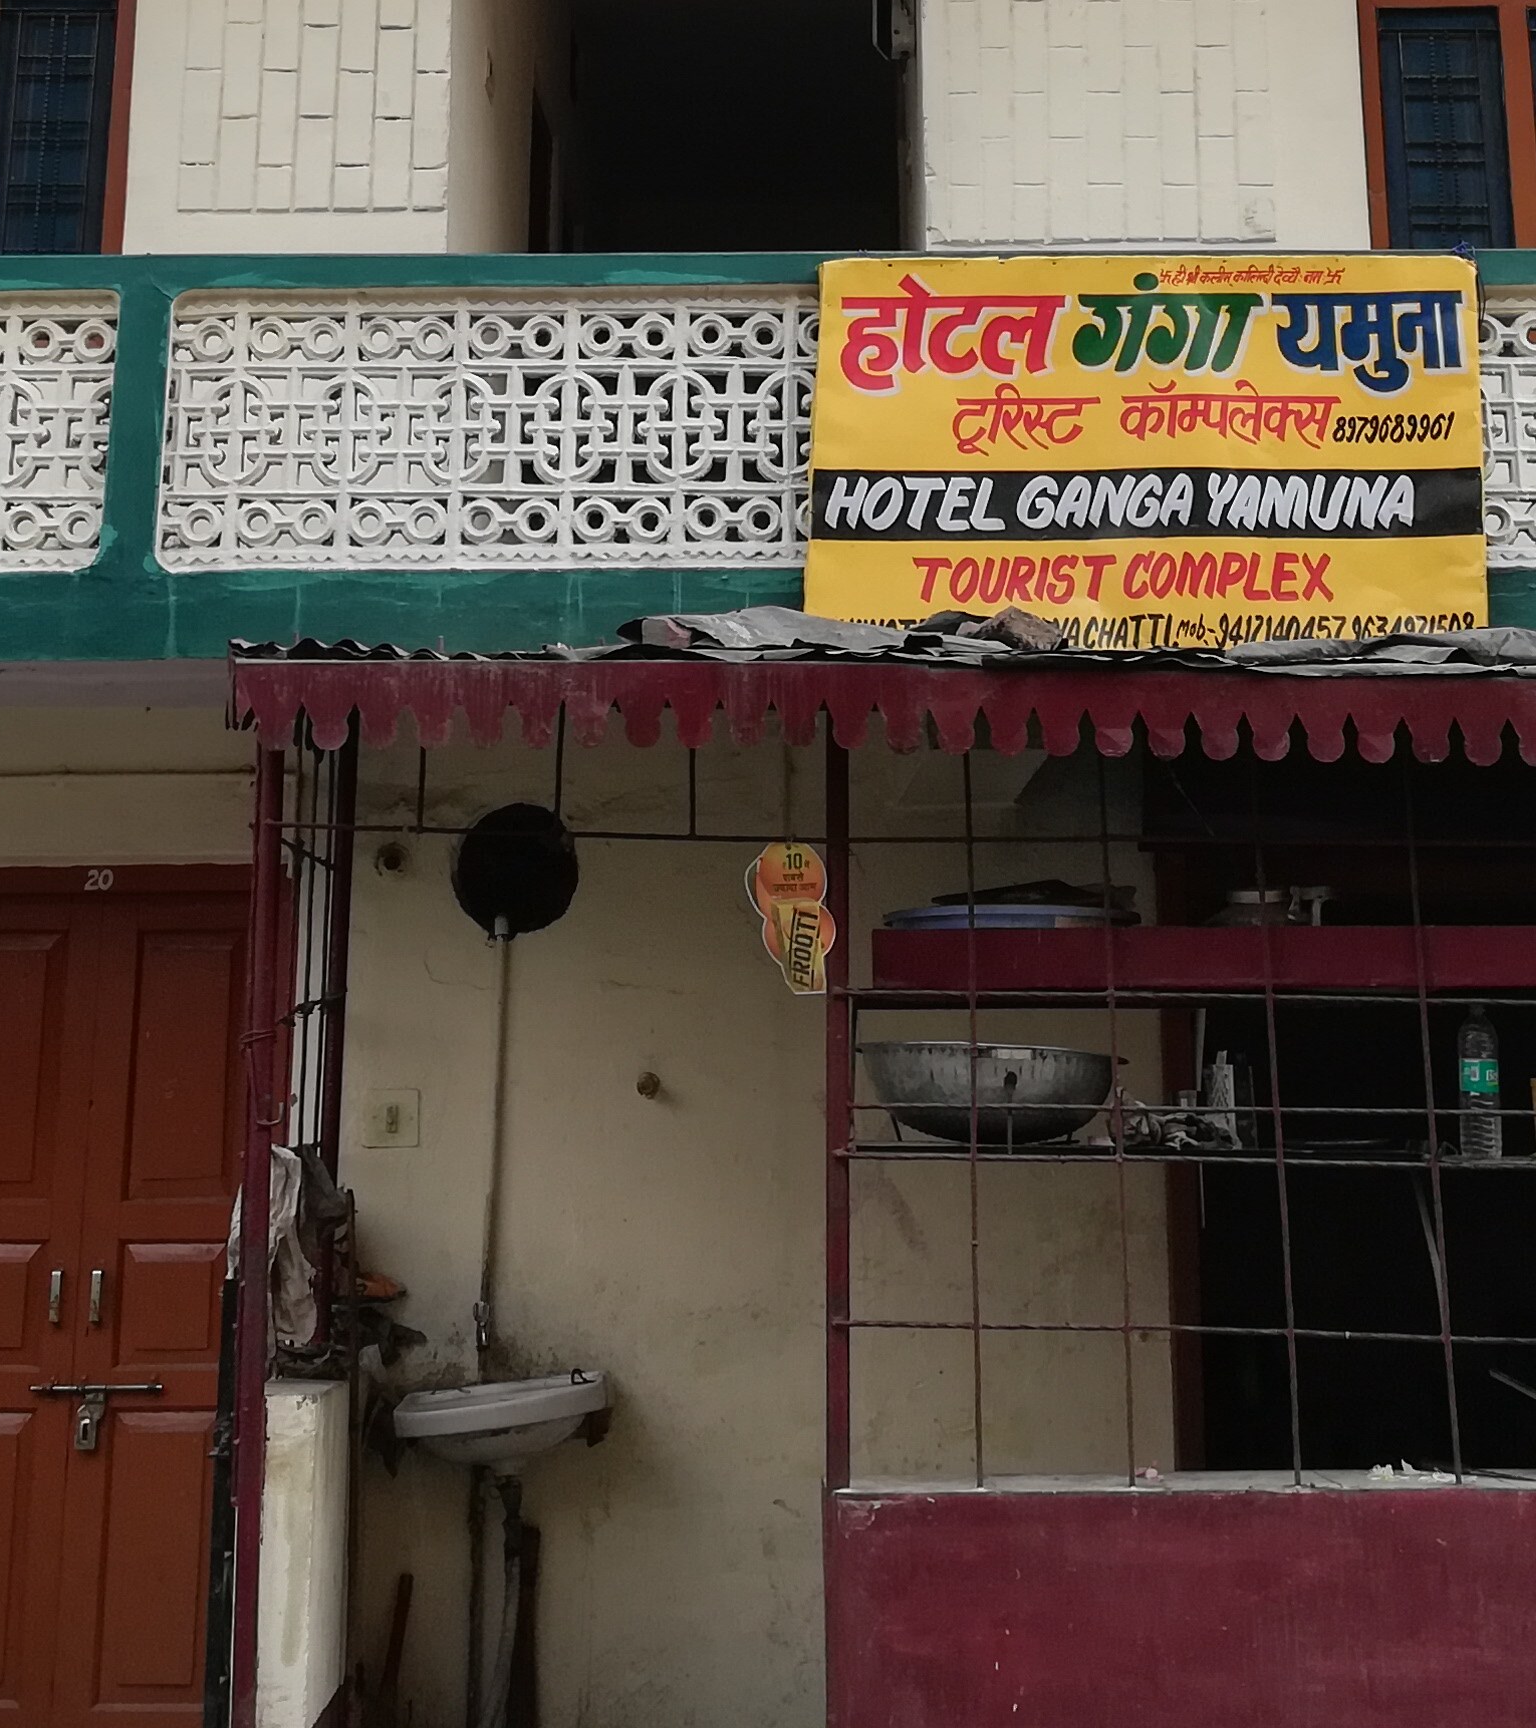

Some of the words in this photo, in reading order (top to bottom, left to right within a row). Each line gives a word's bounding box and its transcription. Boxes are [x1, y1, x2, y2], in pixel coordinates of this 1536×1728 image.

[840, 274, 1068, 393] होटल
[1072, 272, 1265, 373] गंगा
[1271, 290, 1463, 393] यमुना
[952, 383, 1102, 457] टूरिस्ट
[1120, 379, 1342, 449] कॉम्पलेक्स
[1332, 410, 1456, 444] 8979689961
[825, 475, 1006, 531] HOTEL
[1016, 472, 1195, 530] GANGA
[1207, 472, 1415, 531] YAMUNA
[912, 554, 1117, 605] TOURIST
[1123, 551, 1334, 603] COMPLEX
[84, 869, 114, 891] 20
[793, 910, 819, 987] FROOTI
